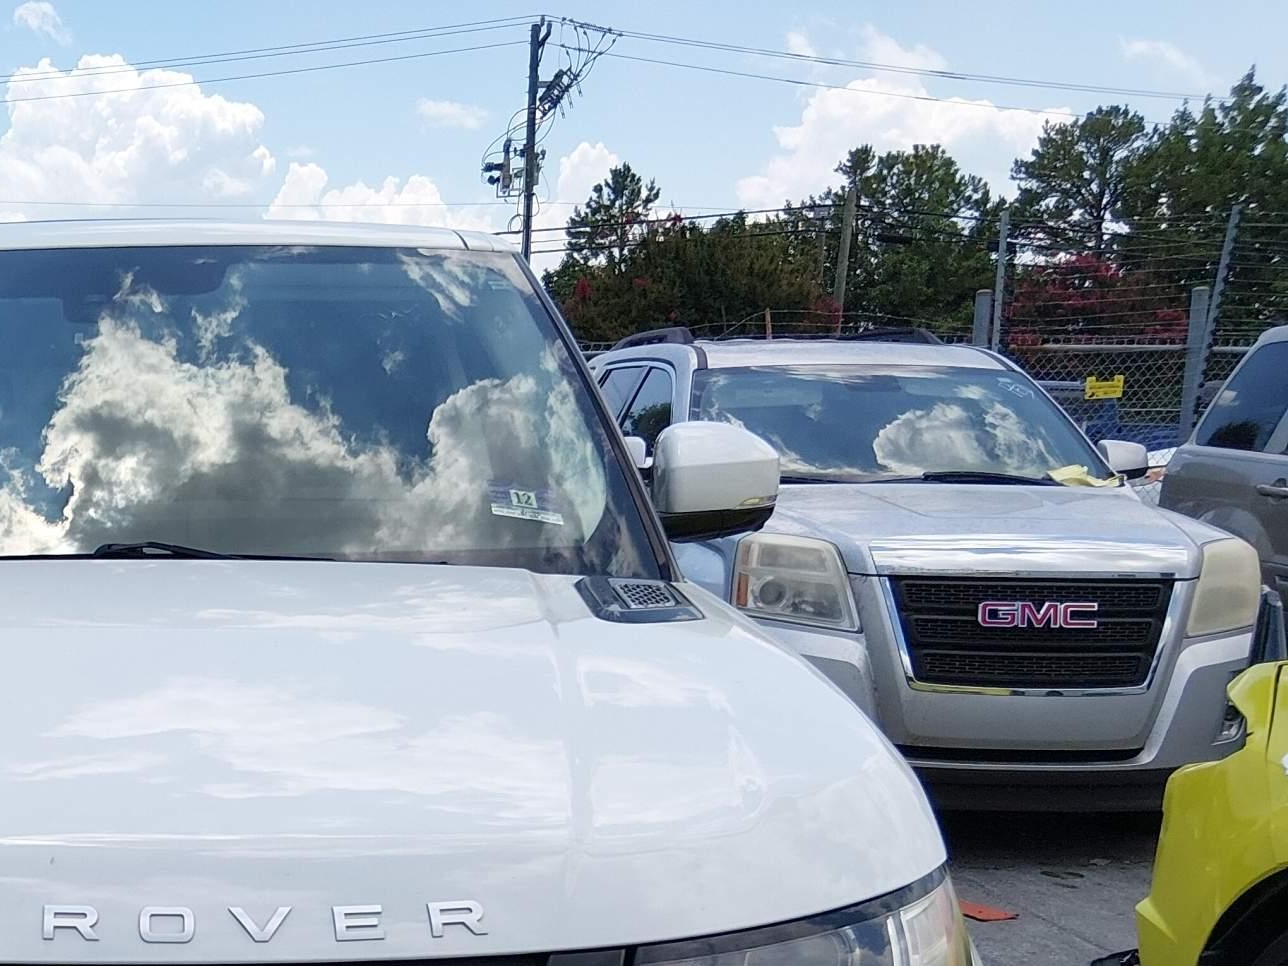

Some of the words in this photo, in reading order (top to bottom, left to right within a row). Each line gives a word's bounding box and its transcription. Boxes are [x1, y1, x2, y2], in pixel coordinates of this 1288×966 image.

[513, 491, 534, 506] 12
[977, 601, 1099, 629] GMC
[42, 900, 489, 943] ROVER
